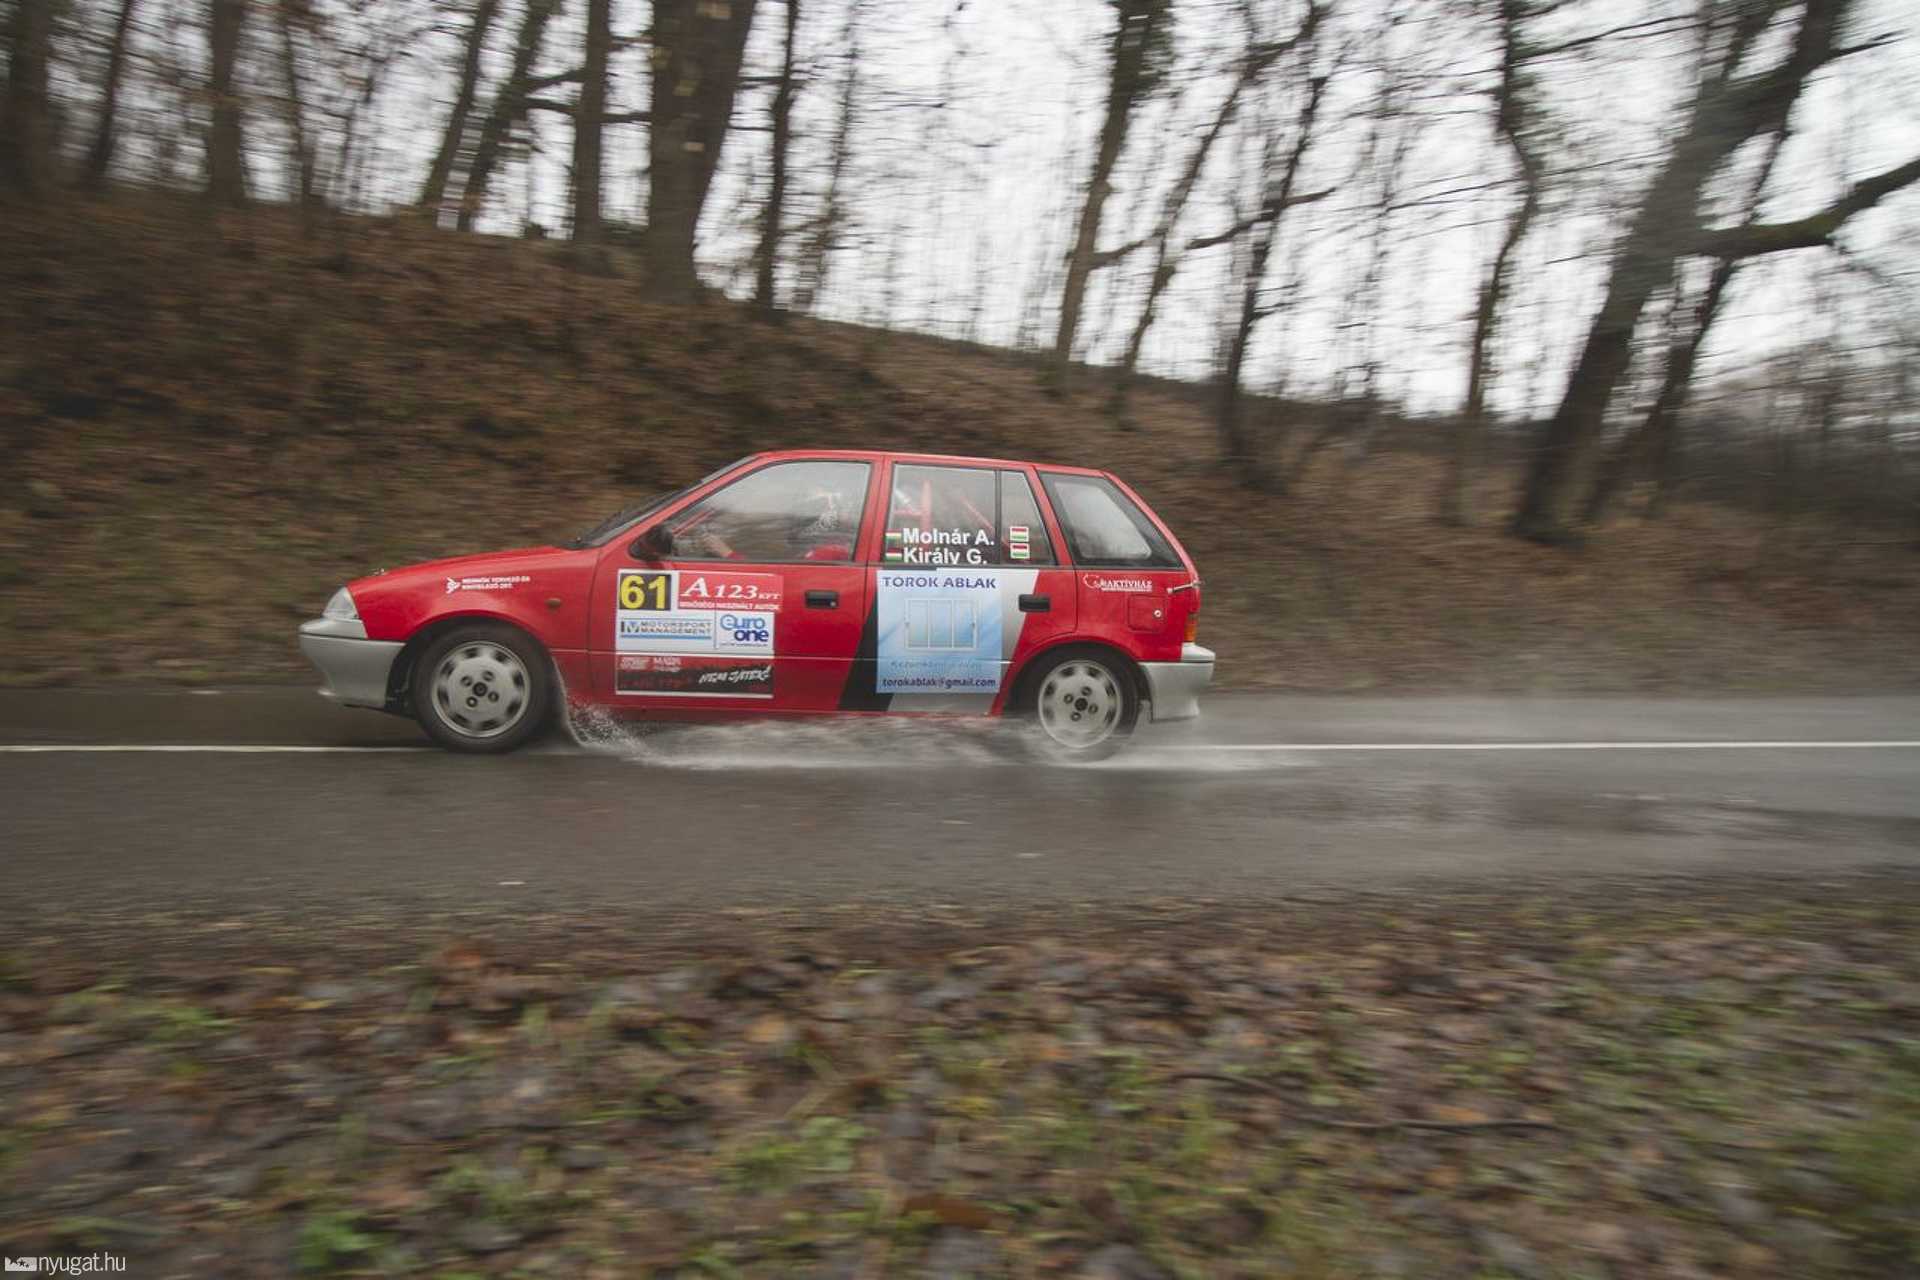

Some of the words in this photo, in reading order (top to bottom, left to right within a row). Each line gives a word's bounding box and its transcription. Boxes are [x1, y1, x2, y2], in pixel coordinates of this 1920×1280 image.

[902, 527, 971, 545] Molnár
[975, 529, 995, 546] A.
[903, 547, 960, 565] Király
[966, 549, 988, 565] G.
[943, 578, 996, 589] ABLAK
[620, 575, 666, 609] 61
[720, 614, 765, 630] euro
[640, 627, 712, 635] MANAGEMENT
[734, 629, 769, 642] one
[883, 679, 996, 689] torokablak@gmail.com
